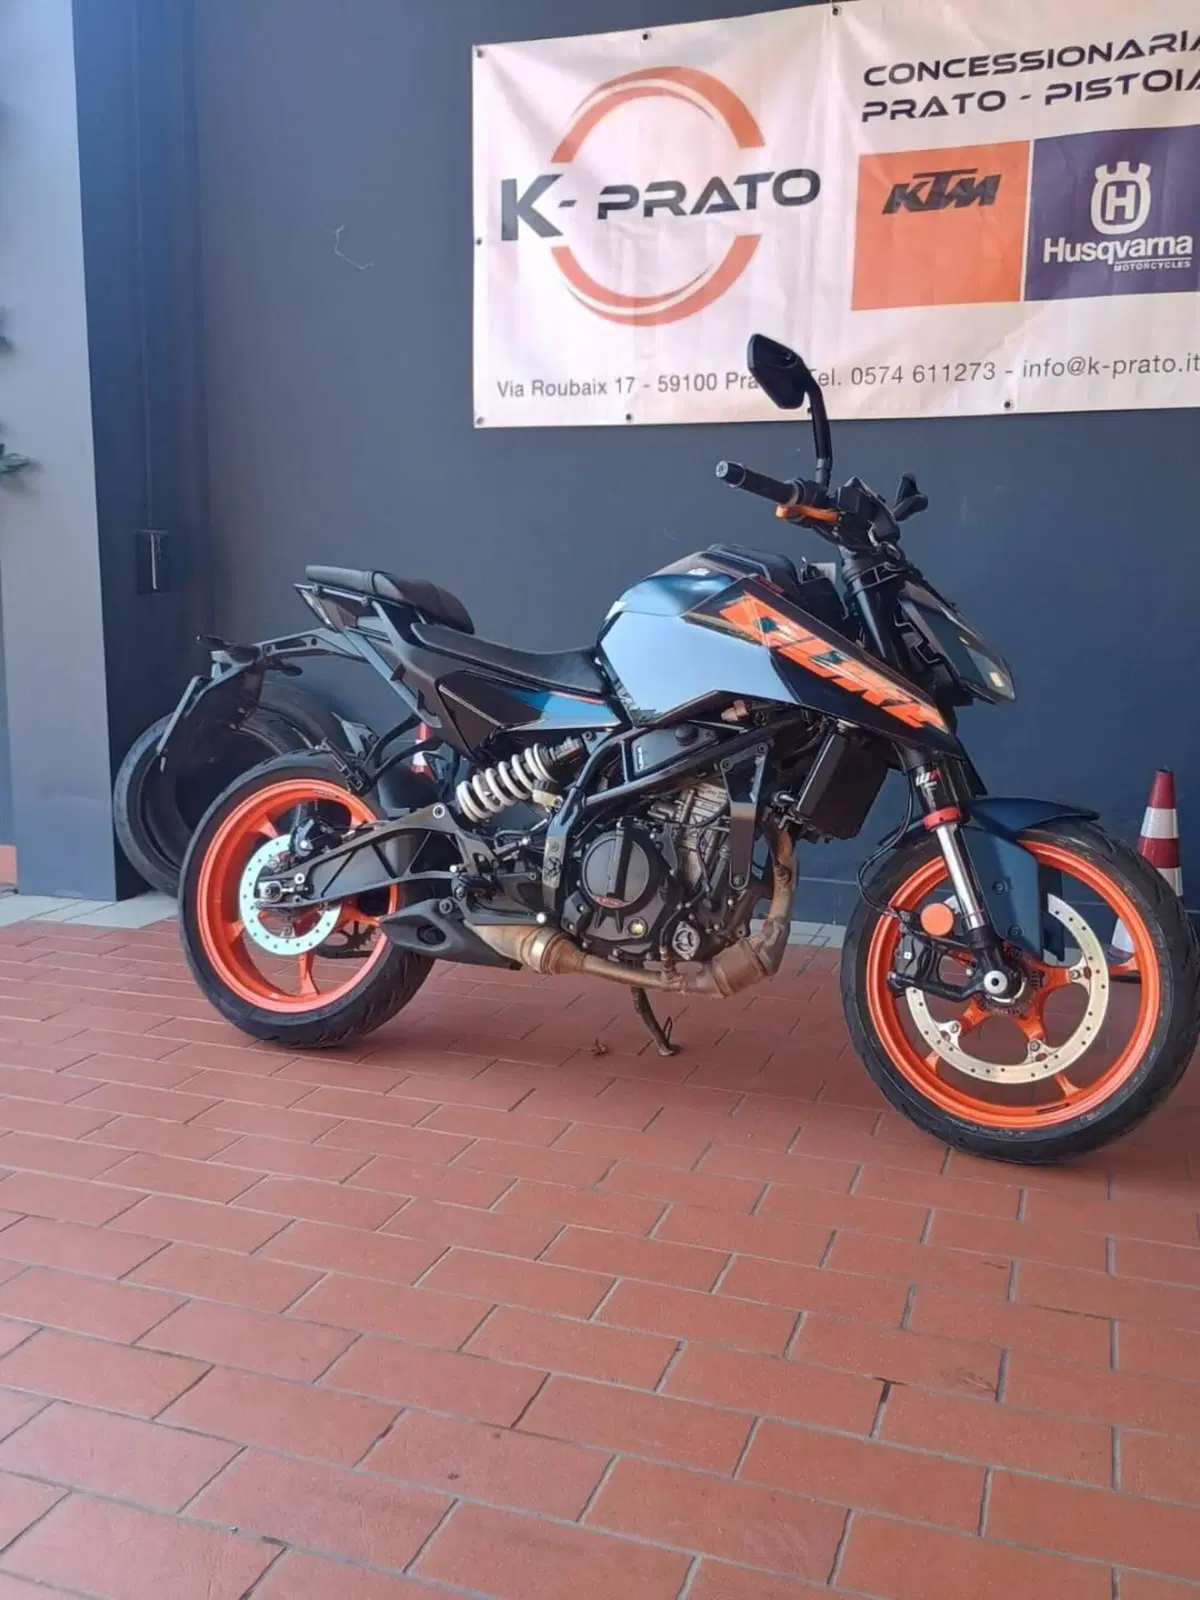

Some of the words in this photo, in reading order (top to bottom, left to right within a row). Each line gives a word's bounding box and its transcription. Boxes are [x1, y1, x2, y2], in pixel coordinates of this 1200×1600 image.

[861, 90, 1007, 123] PRATO
[597, 168, 821, 220] PRATO
[881, 168, 1002, 215] KTM
[1104, 184, 1137, 221] H
[1043, 235, 1194, 265] Husqvarna
[1113, 261, 1192, 272] MOTORCYCLES
[497, 380, 524, 397] Via
[531, 377, 606, 397] Roubaix
[614, 376, 635, 394] 17
[658, 373, 717, 392] 59100
[851, 366, 904, 386] 0574
[912, 361, 996, 383] 611273
[1022, 352, 1200, 379] info@k-prato.it
